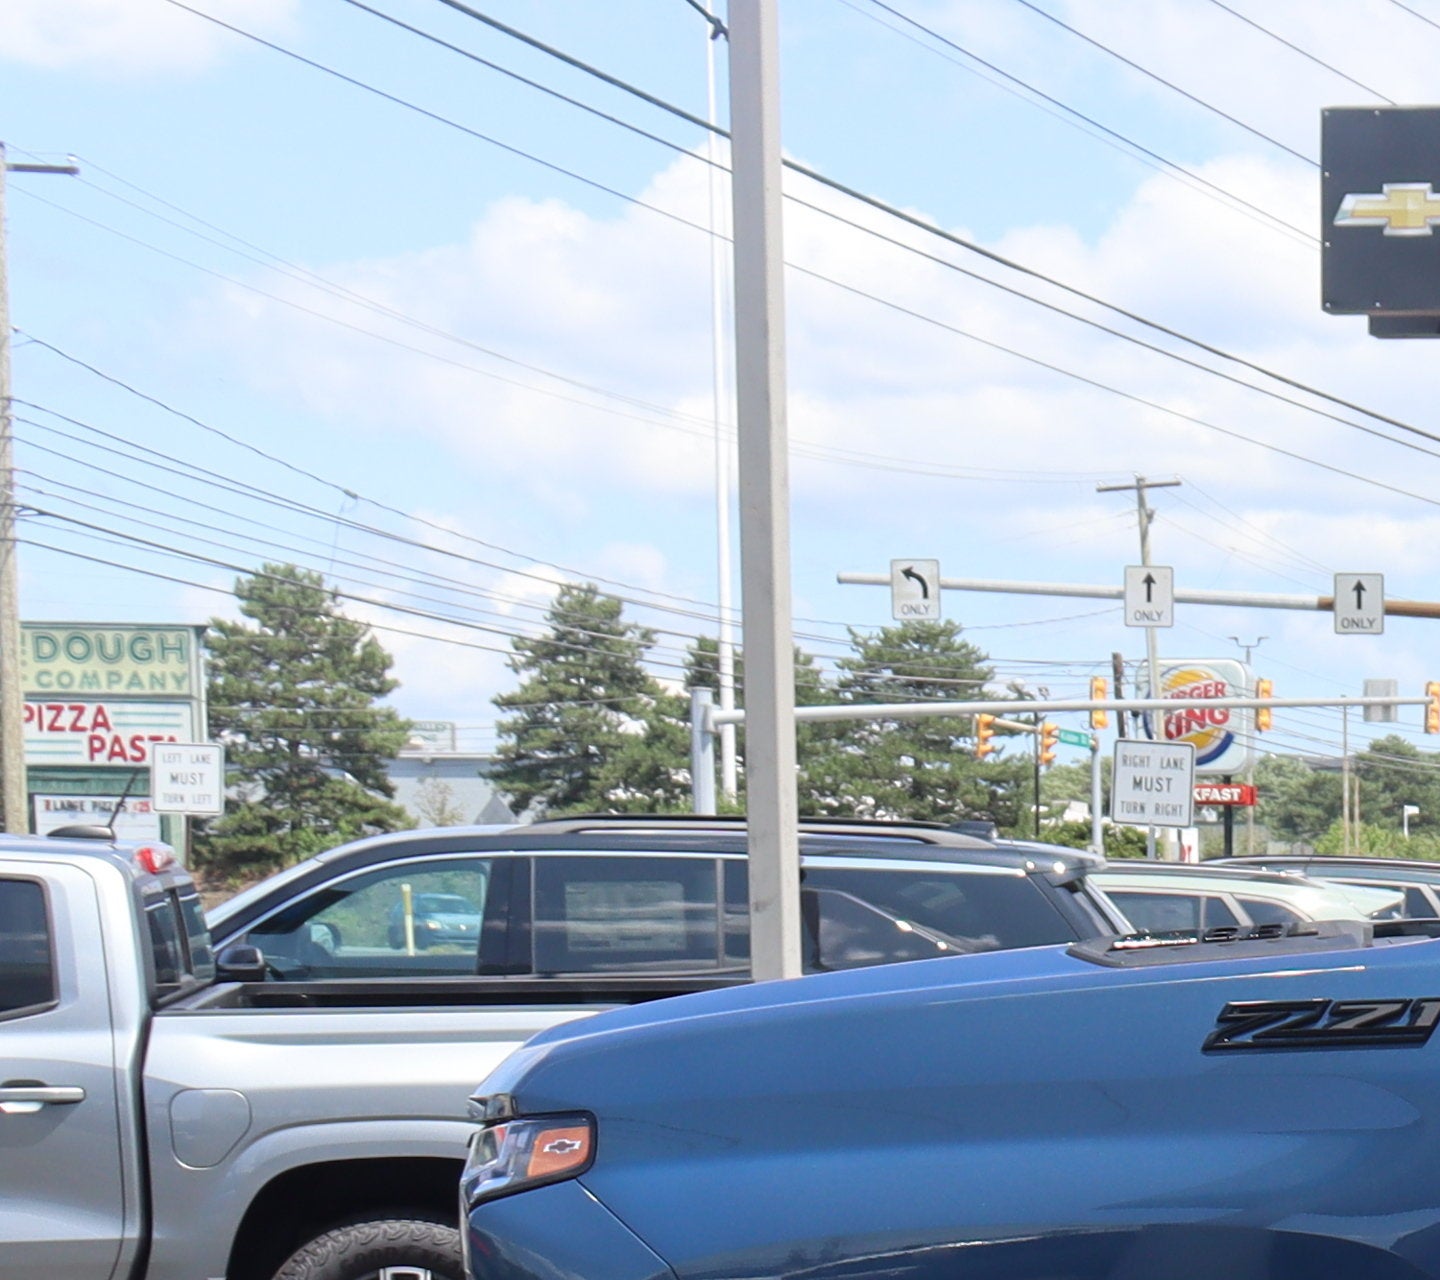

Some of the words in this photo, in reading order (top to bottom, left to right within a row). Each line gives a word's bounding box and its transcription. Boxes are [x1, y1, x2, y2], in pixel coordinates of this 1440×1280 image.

[900, 604, 930, 617] ONLY
[1133, 609, 1163, 622] ONLY
[1340, 617, 1377, 630] ONLY
[32, 631, 188, 664] DOUGH
[35, 669, 188, 689] COMPANY
[23, 703, 113, 733] PIZZA
[88, 734, 178, 763] PAS
[162, 752, 182, 765] LEFT
[190, 752, 212, 765] LANE
[1122, 754, 1151, 768] RIGHT
[1160, 756, 1185, 771] LANE
[170, 772, 205, 786] MUST
[1132, 774, 1173, 793] MUST
[192, 793, 212, 805] LEFT
[1120, 800, 1146, 815] TURN
[1154, 802, 1184, 817] RIGHT
